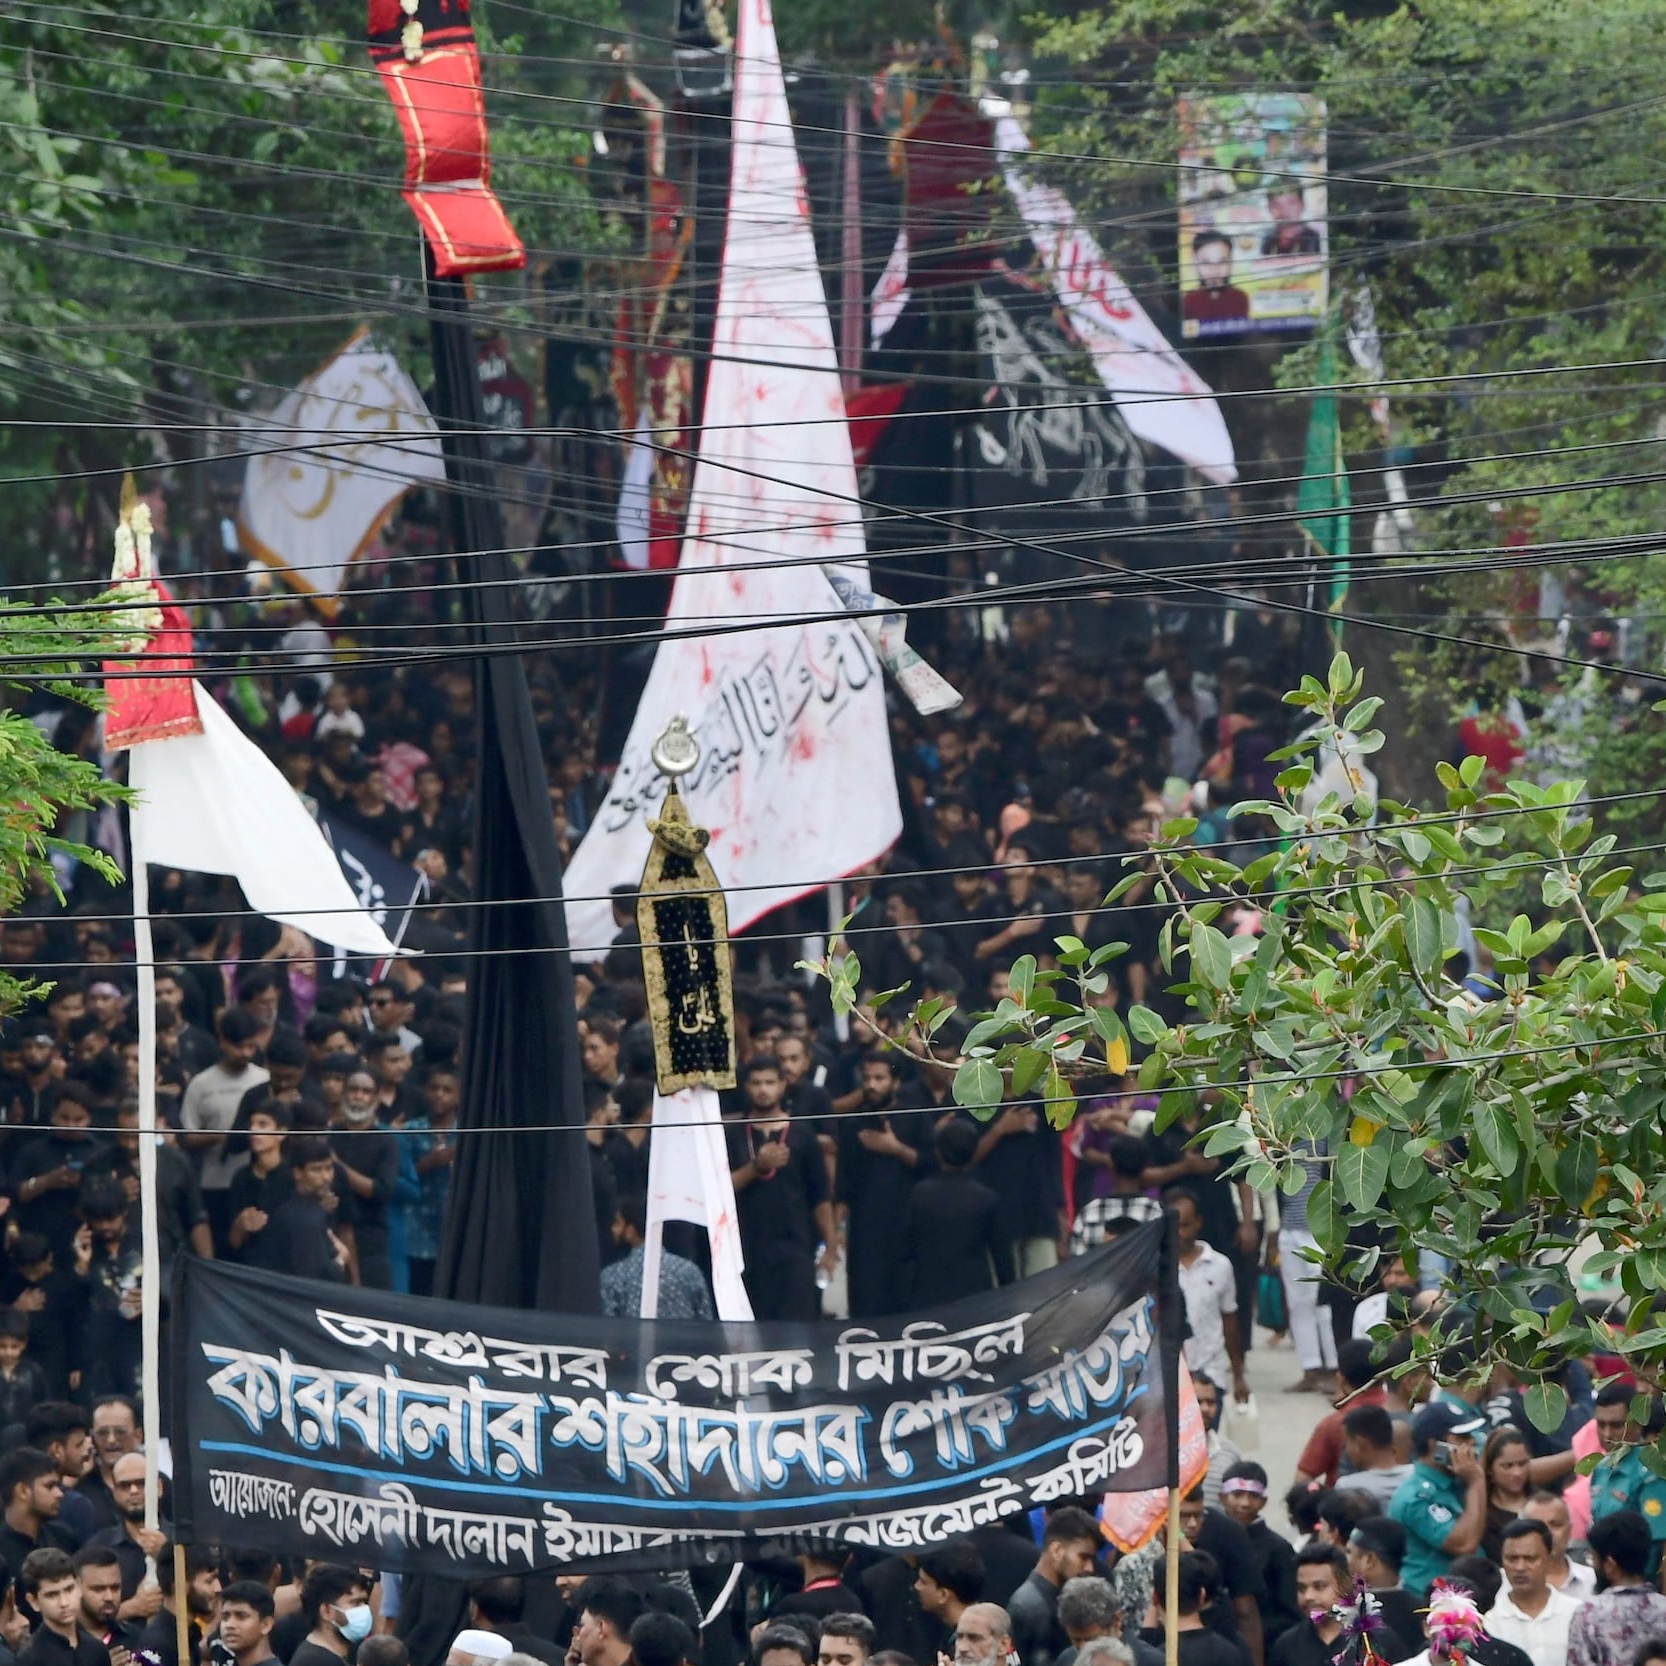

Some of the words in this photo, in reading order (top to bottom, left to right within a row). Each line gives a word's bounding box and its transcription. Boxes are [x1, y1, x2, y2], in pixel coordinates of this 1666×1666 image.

[200, 1342, 551, 1481] কারবালার
[549, 1390, 873, 1496] শহীদানের
[880, 1383, 1020, 1479] শোক
[1021, 1294, 1155, 1421] মাতম
[315, 1308, 610, 1389] আশুরার
[645, 1349, 815, 1399] শোক
[835, 1312, 1032, 1391] মিছিল
[422, 1506, 538, 1568] দালান
[1024, 1416, 1145, 1501] কমিটি
